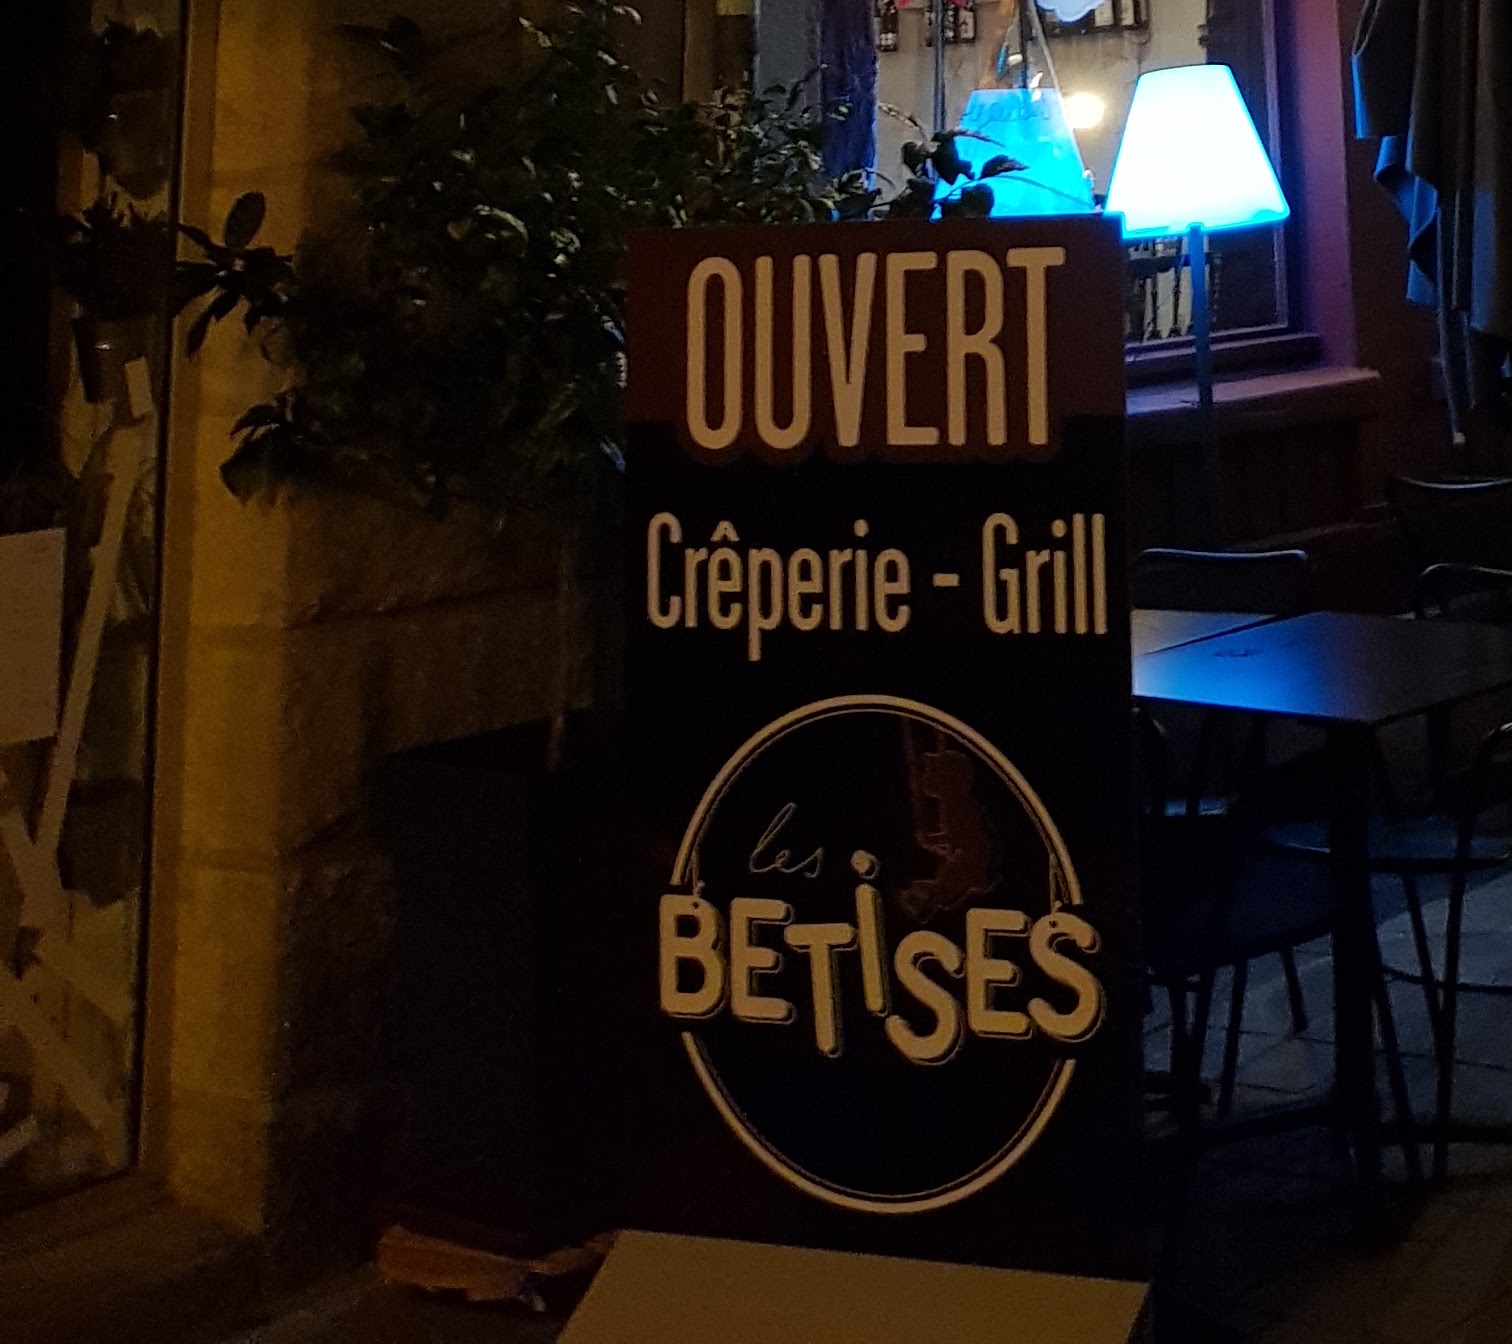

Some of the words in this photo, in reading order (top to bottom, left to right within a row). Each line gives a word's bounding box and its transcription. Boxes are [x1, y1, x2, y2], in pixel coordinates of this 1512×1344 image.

[684, 246, 1067, 451] OUVERT
[646, 511, 912, 662] Crêperie
[980, 511, 1109, 636] Grill
[747, 802, 824, 876] les
